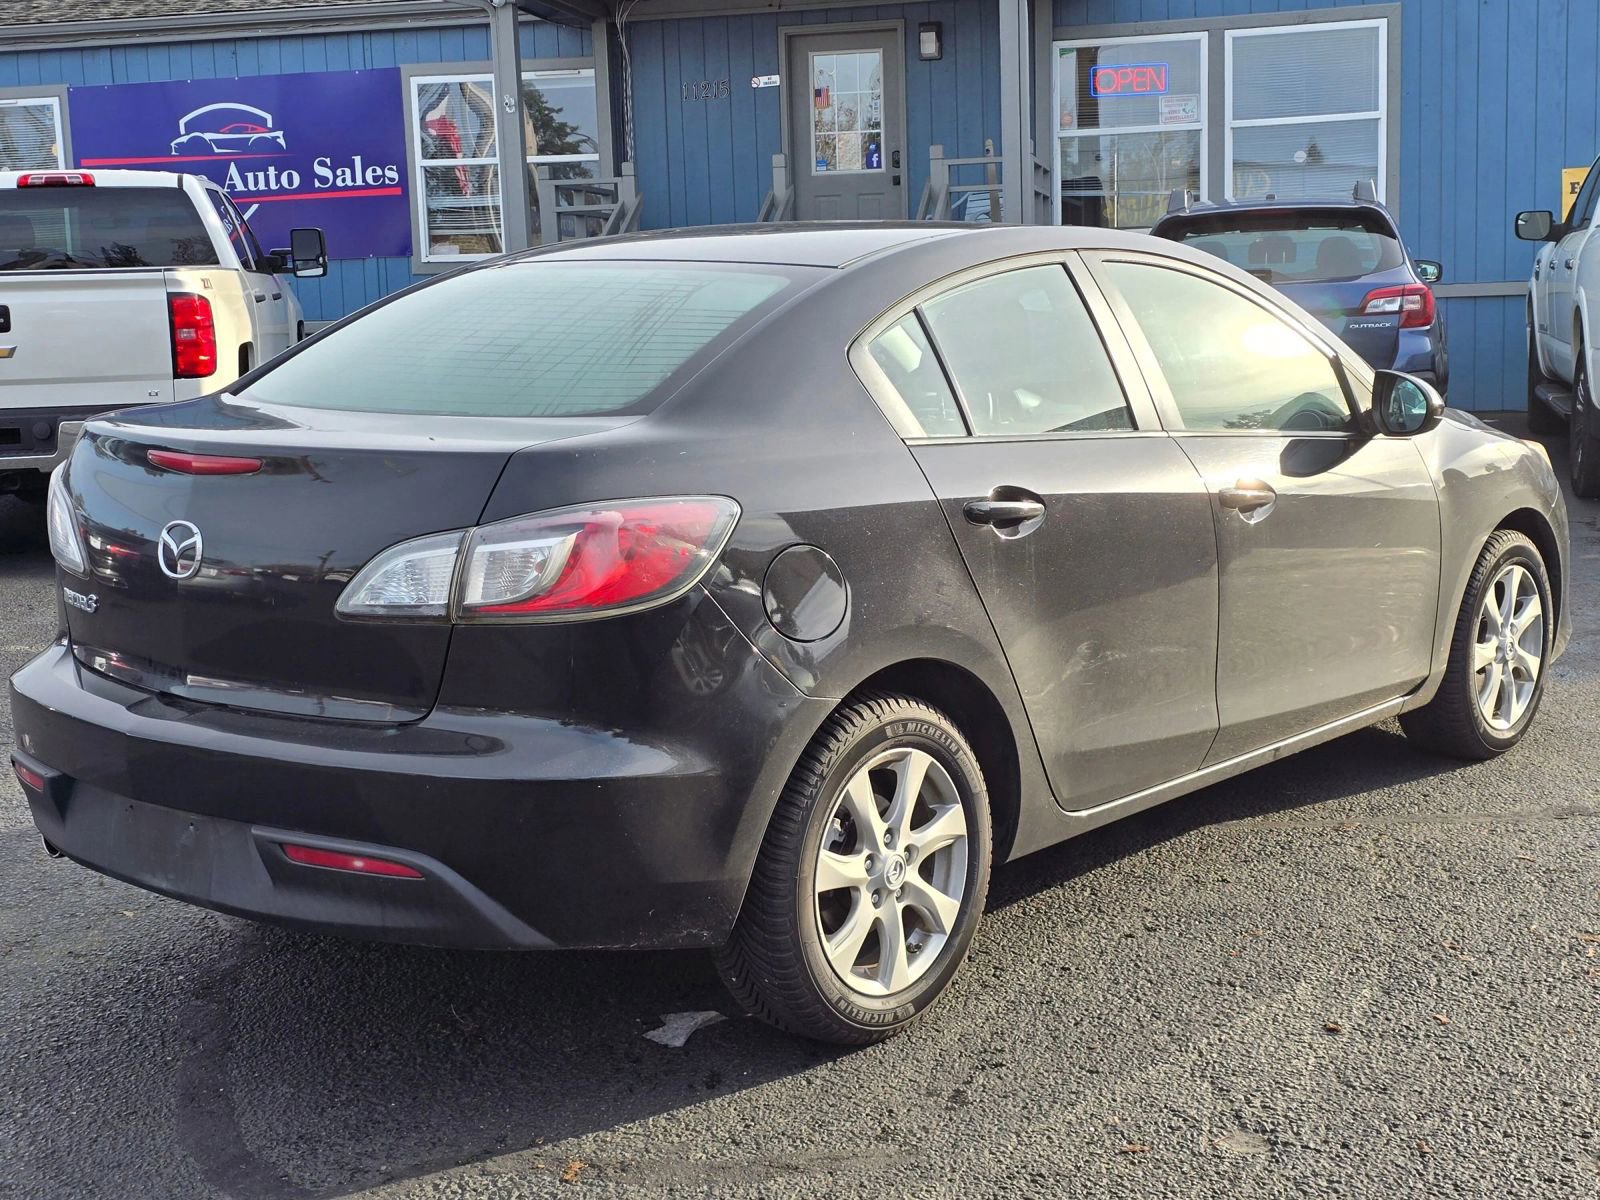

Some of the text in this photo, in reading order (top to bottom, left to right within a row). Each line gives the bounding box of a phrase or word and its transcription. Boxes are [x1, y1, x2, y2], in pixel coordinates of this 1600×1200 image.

[682, 79, 730, 101] 11215
[1095, 66, 1165, 93] OPEN
[224, 155, 400, 192] Auto Sales
[905, 722, 959, 753] MICHELIN
[837, 999, 895, 1023] MICHELIN
